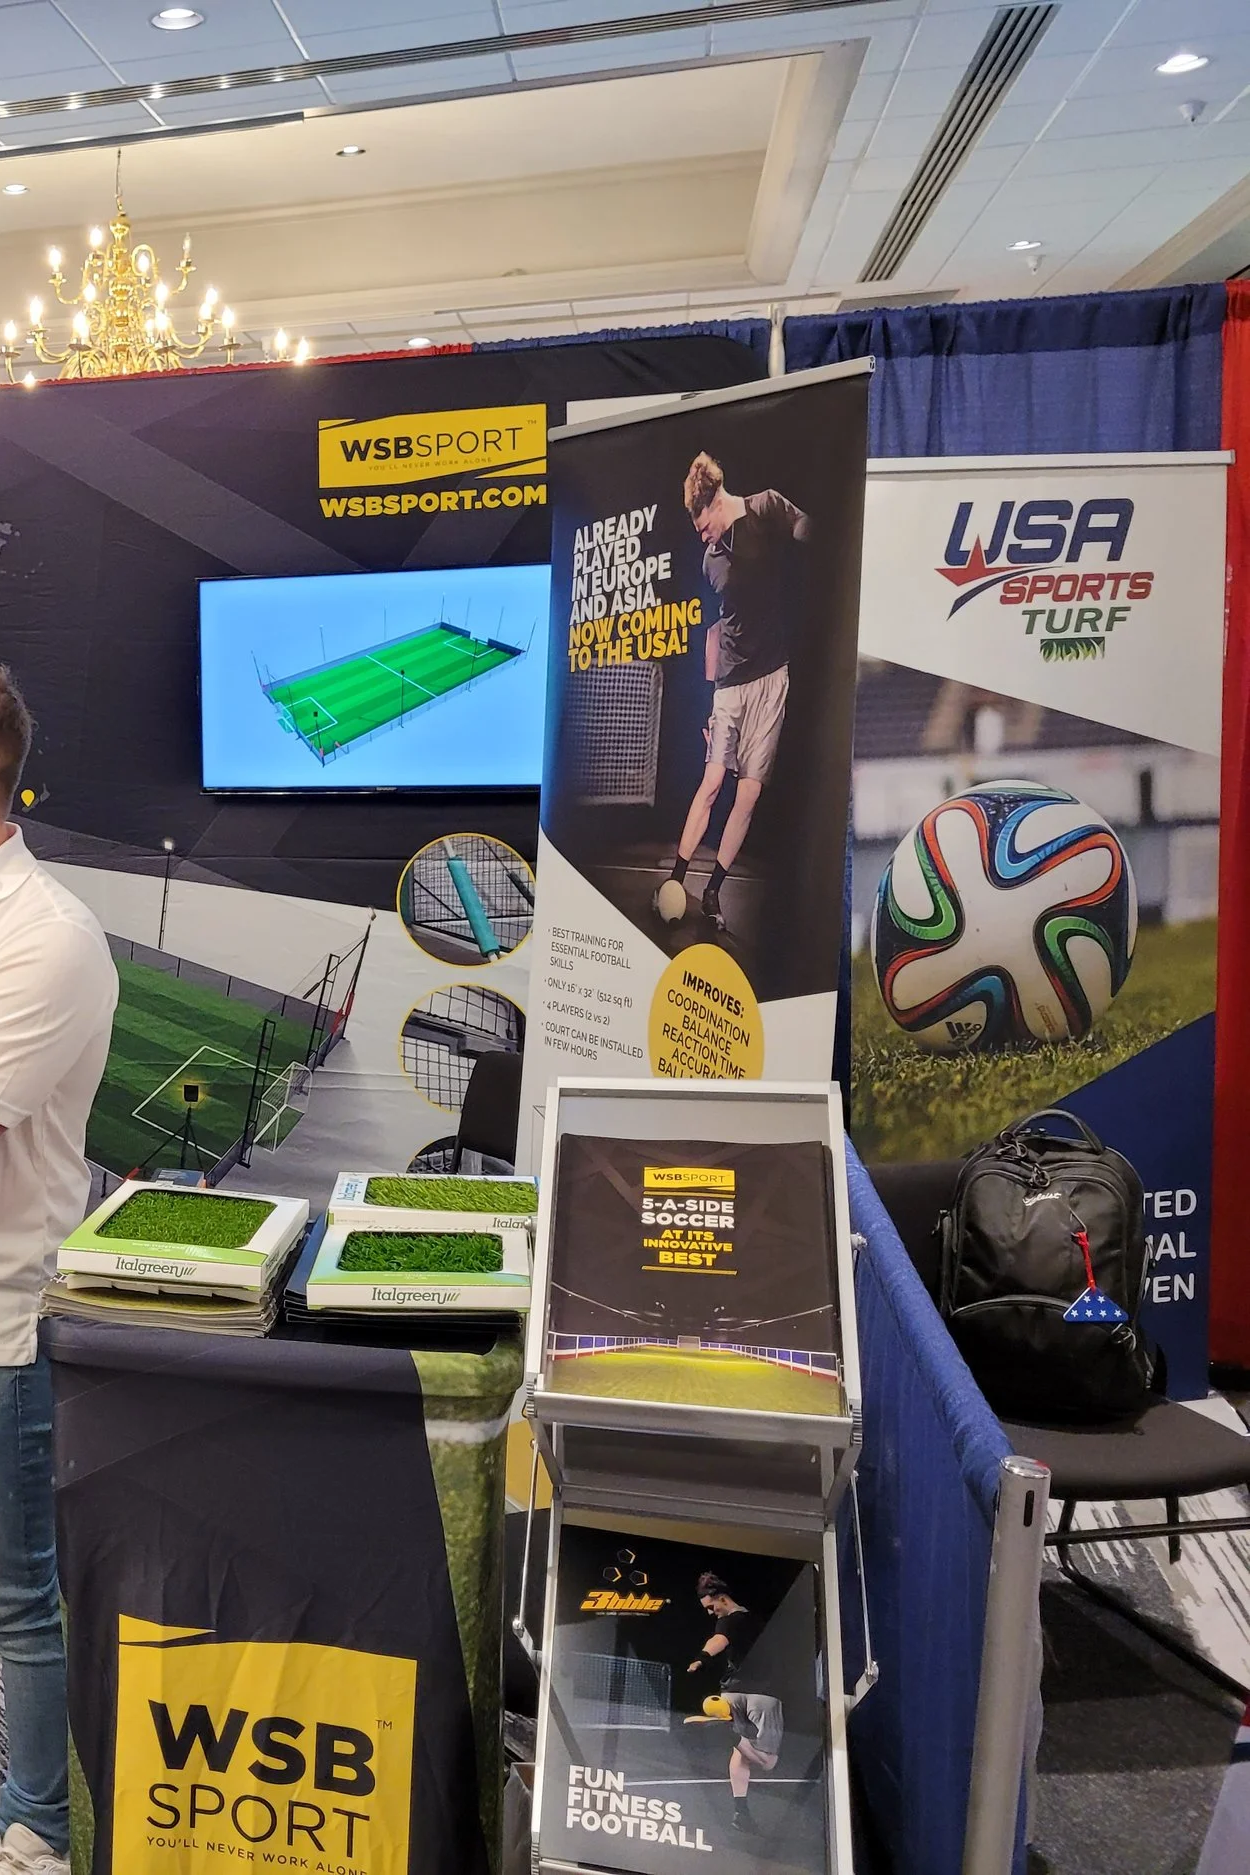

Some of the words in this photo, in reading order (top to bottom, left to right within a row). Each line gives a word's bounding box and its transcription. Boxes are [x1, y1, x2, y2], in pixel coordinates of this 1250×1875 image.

[340, 427, 523, 462] WSBSPORT
[319, 484, 547, 518] WSBSPORT.COM
[573, 504, 658, 555] ALREADY
[944, 498, 1135, 566] USA
[573, 536, 641, 577] PLAYED
[571, 574, 587, 601] IN
[592, 552, 672, 595] EUROPE
[999, 571, 1155, 605] SPORTS
[570, 595, 607, 625] AND
[610, 582, 661, 616] ASIA.
[1021, 606, 1132, 635] TURF
[569, 616, 615, 649] NOW
[617, 598, 702, 640] COMING
[568, 646, 592, 673] TO
[595, 637, 633, 668] THE
[637, 626, 688, 660] USA!
[551, 941, 590, 960] ESSENTIAL
[590, 949, 631, 969] FOOTBALL
[552, 927, 570, 940] BEST
[571, 930, 607, 948] TRAINING
[608, 937, 624, 952] FOR
[549, 956, 574, 971] SKILLS
[547, 977, 567, 991] ONLY
[682, 970, 745, 1019] IMPROVES:
[552, 1001, 584, 1020] PLAYERS
[667, 989, 750, 1048] COORDINATION
[544, 1036, 551, 1046] IN
[551, 1038, 570, 1055] FEW
[570, 1042, 598, 1061] HOURS
[545, 1020, 570, 1038] COURT
[571, 1028, 588, 1044] CAN
[588, 1033, 599, 1046] BE
[599, 1036, 643, 1059] INSTALLED
[662, 1022, 718, 1067] REACTION
[720, 1055, 746, 1079] TIME
[681, 1015, 732, 1056] BALANCE
[653, 1173, 725, 1183] WSBSPORT
[640, 1211, 735, 1229] SOCCER
[641, 1197, 734, 1214] 5-A-SIDE
[643, 1238, 733, 1252] INNOVATIVE
[661, 1229, 683, 1240] AT
[687, 1230, 715, 1241] ITS
[115, 1256, 185, 1278] Italgreen
[658, 1250, 717, 1266] BEST
[371, 1287, 448, 1304] Italgreen
[148, 1699, 376, 1797] WSB
[568, 1764, 625, 1791] FUN
[146, 1783, 370, 1858] SPORT
[567, 1786, 682, 1823] FITNESS
[566, 1808, 713, 1852] FOOTBALL
[146, 1836, 199, 1849] YOU'LL
[206, 1842, 255, 1861] NEVER
[262, 1853, 309, 1868] WORK
